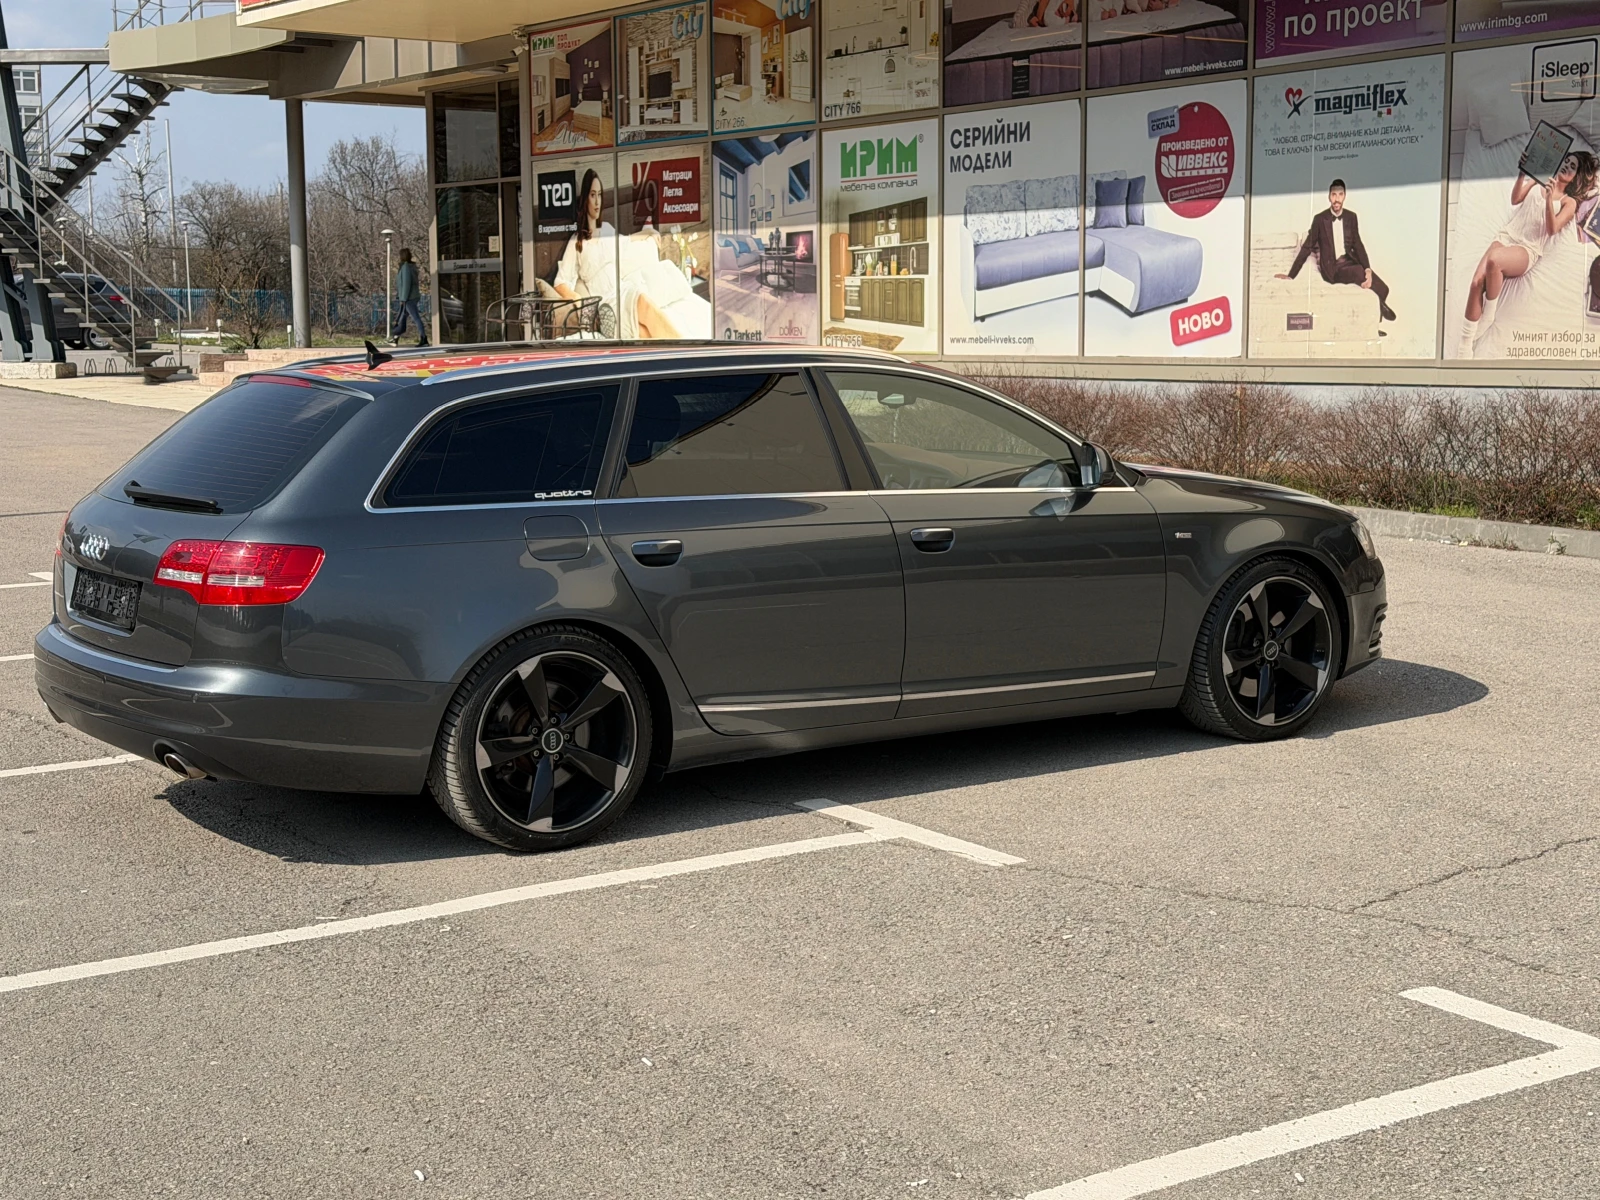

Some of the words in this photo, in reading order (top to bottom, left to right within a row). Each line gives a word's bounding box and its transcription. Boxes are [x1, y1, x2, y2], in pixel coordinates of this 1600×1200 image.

[672, 12, 703, 39] City
[1284, 13, 1317, 38] по
[1326, 0, 1423, 37] проект
[1460, 13, 1548, 32] www.irimbg.com
[532, 36, 555, 51] ИРИМ
[557, 33, 568, 42] ТОП
[557, 40, 581, 50] ПРОДУКТ
[1164, 59, 1244, 76] www.mebeli-ivveks.com
[1571, 80, 1588, 88] Smart
[1314, 83, 1408, 115] magniflex
[824, 103, 844, 118] CITY
[845, 100, 861, 116] 766
[715, 119, 731, 130] CITY
[732, 116, 745, 128] 266
[1151, 120, 1176, 132] СКЛАД
[950, 118, 1031, 149] СЕРИЙНИ
[1327, 129, 1363, 140] ВНИМАНИЕ
[1363, 127, 1380, 137] КЪМ
[1380, 124, 1411, 136] ДЕТАЙЛА
[1161, 138, 1216, 152] ПРОИЗВЕДЕНО
[1218, 137, 1229, 147] ОТ
[1265, 148, 1281, 157] ТОВА
[1314, 143, 1329, 152] КЪМ
[1330, 141, 1352, 151] ВСЕКИ
[1352, 137, 1396, 149] ИТАЛИАНСКИ
[1397, 135, 1420, 145] УСПЕХ
[841, 135, 918, 178] ИРИМ
[949, 150, 1012, 174] МОДЕЛИ
[1177, 151, 1228, 170] ИВВЕКС
[662, 170, 692, 183] Матраци
[662, 186, 683, 198] Легла
[840, 183, 876, 192] мебелна
[877, 179, 918, 189] компания
[663, 202, 699, 214] Аксесоари
[1178, 309, 1224, 336] НОВО
[733, 329, 762, 341] Tarkett
[825, 335, 846, 347] CITY
[847, 334, 862, 347] 756
[950, 335, 1034, 345] www.mebeli-ivveks.com
[1512, 331, 1548, 342] Умният
[1551, 330, 1582, 345] избор
[1584, 333, 1596, 343] за
[1506, 347, 1577, 358] здравословен
[534, 489, 593, 500] quattro
